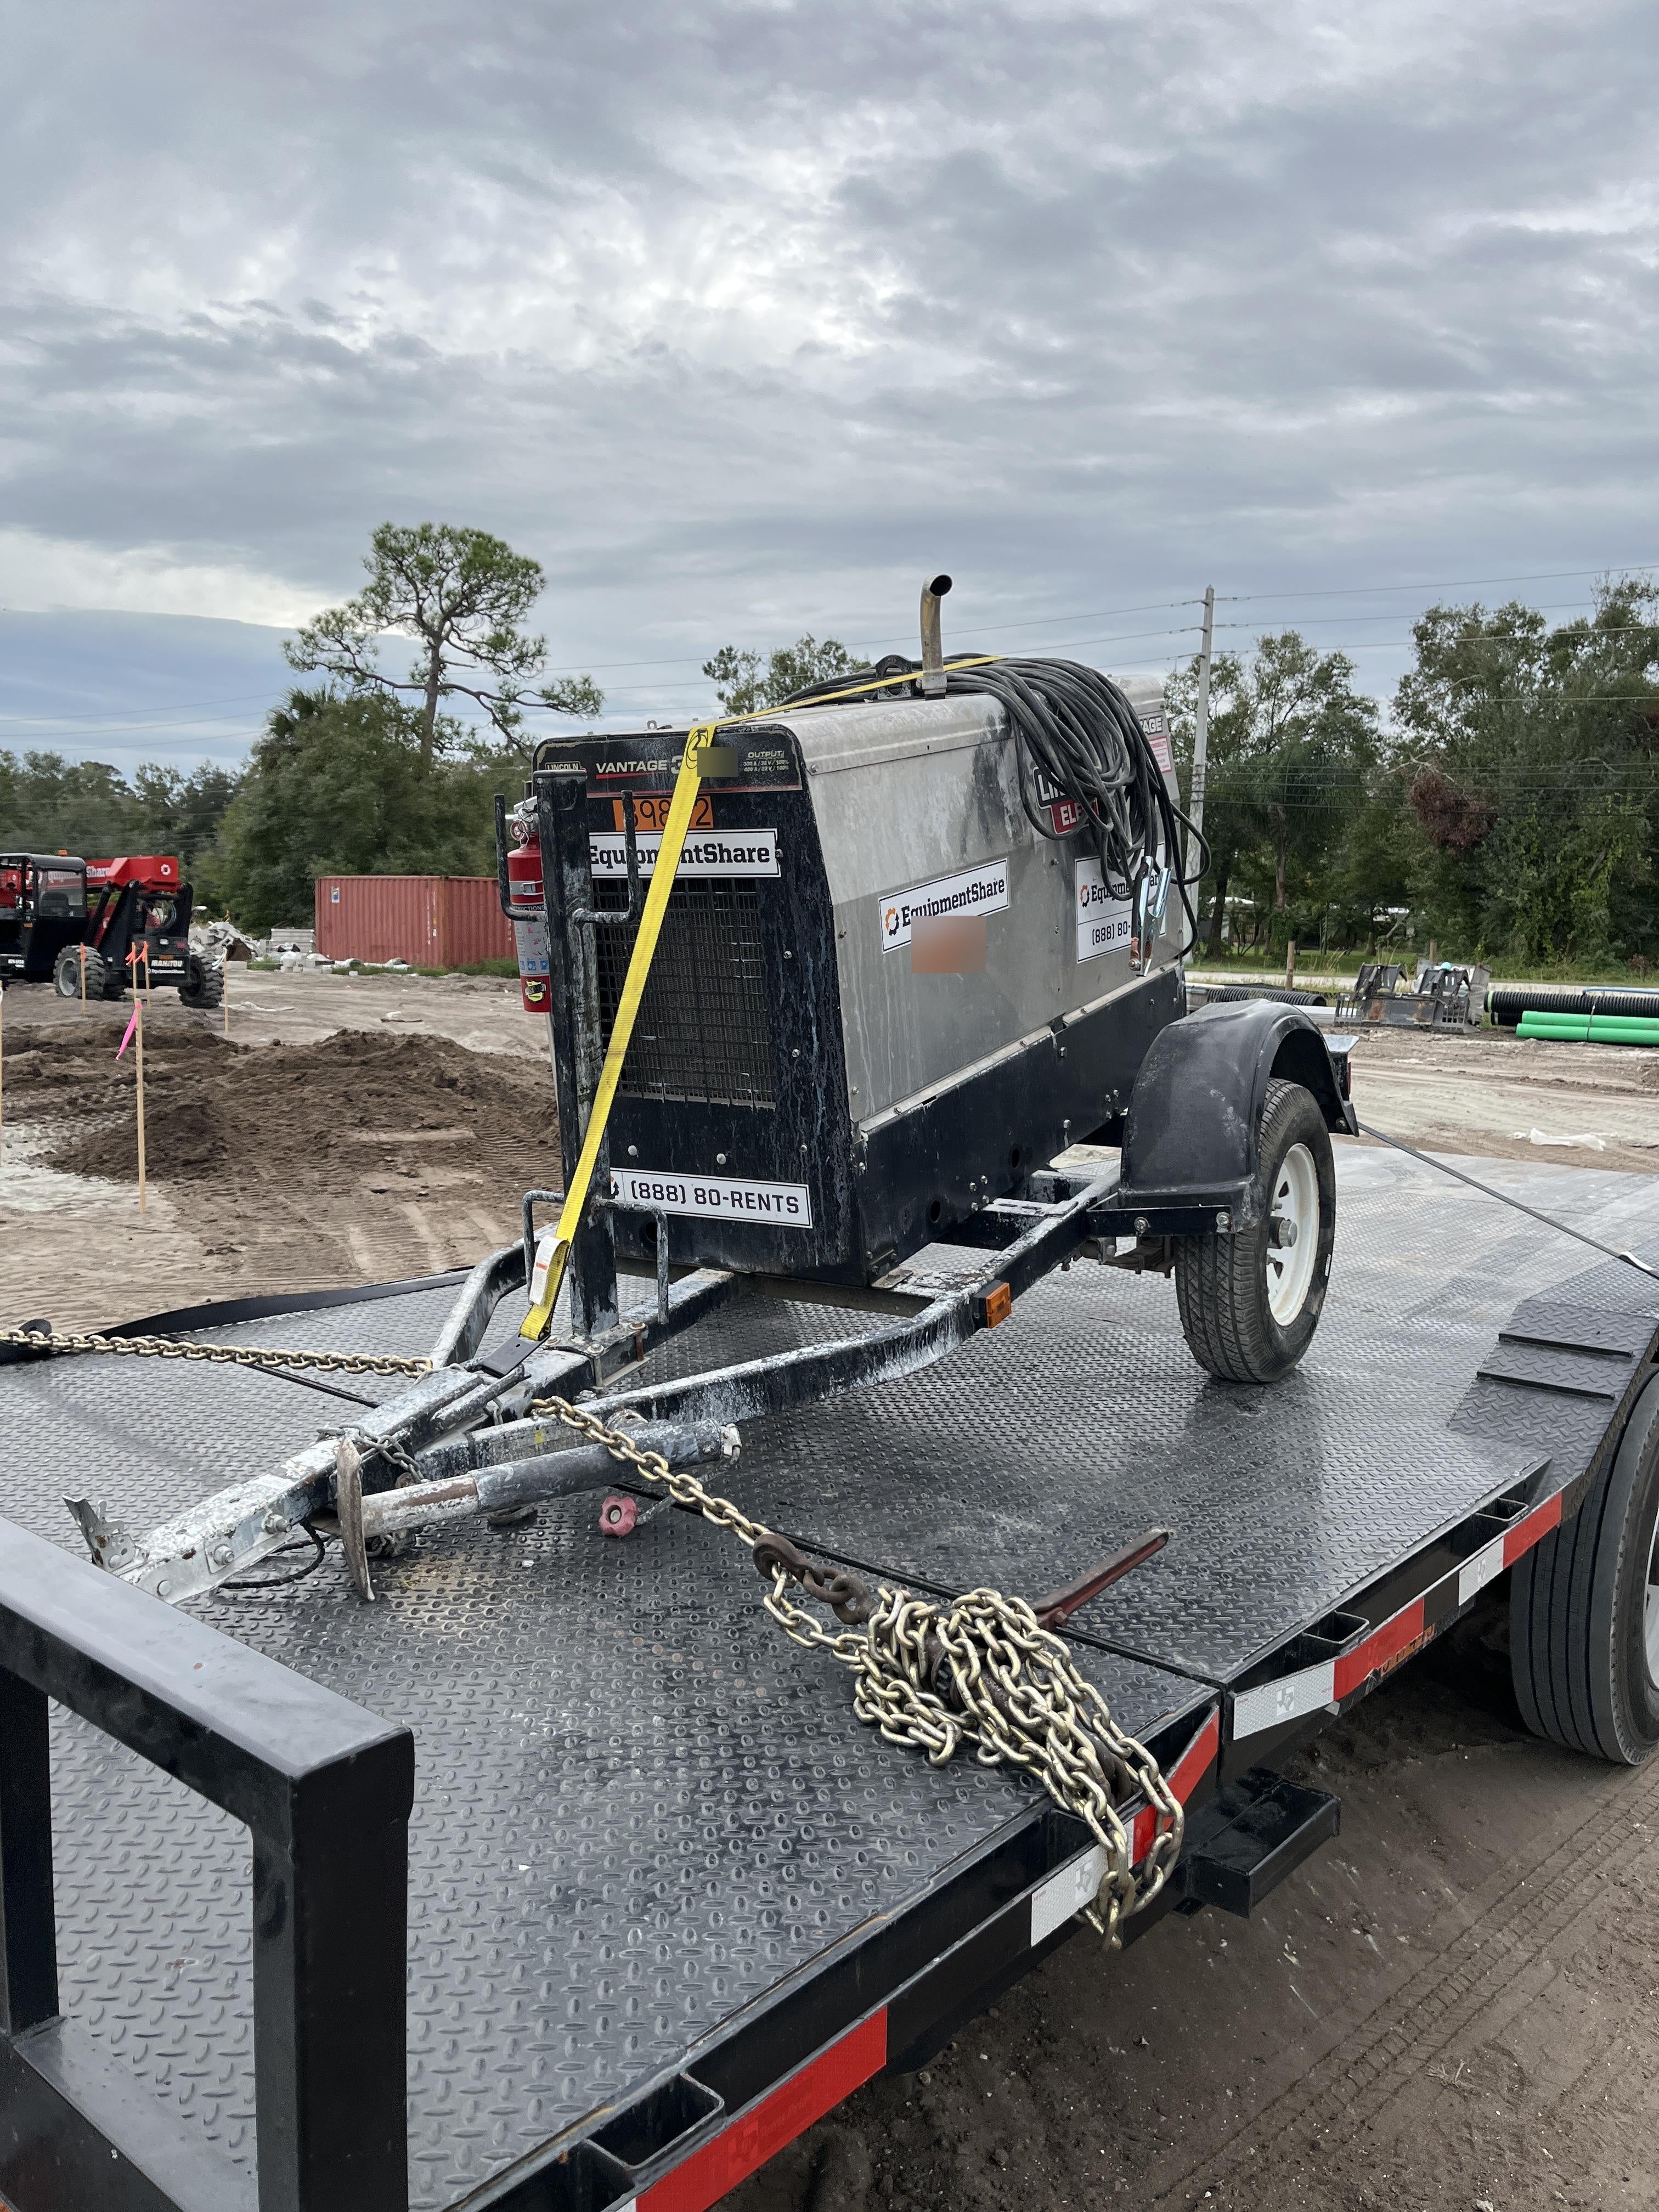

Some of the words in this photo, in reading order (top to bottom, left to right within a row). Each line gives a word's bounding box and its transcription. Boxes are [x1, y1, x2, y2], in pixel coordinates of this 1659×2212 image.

[747, 750, 782, 758] OUTPUT
[596, 760, 668, 774] VANTAGE
[590, 844, 770, 869] EqupmntShare
[1092, 923, 1114, 946] (888)
[631, 1180, 686, 1204] (888)
[694, 1187, 799, 1214] 80-RENTS
